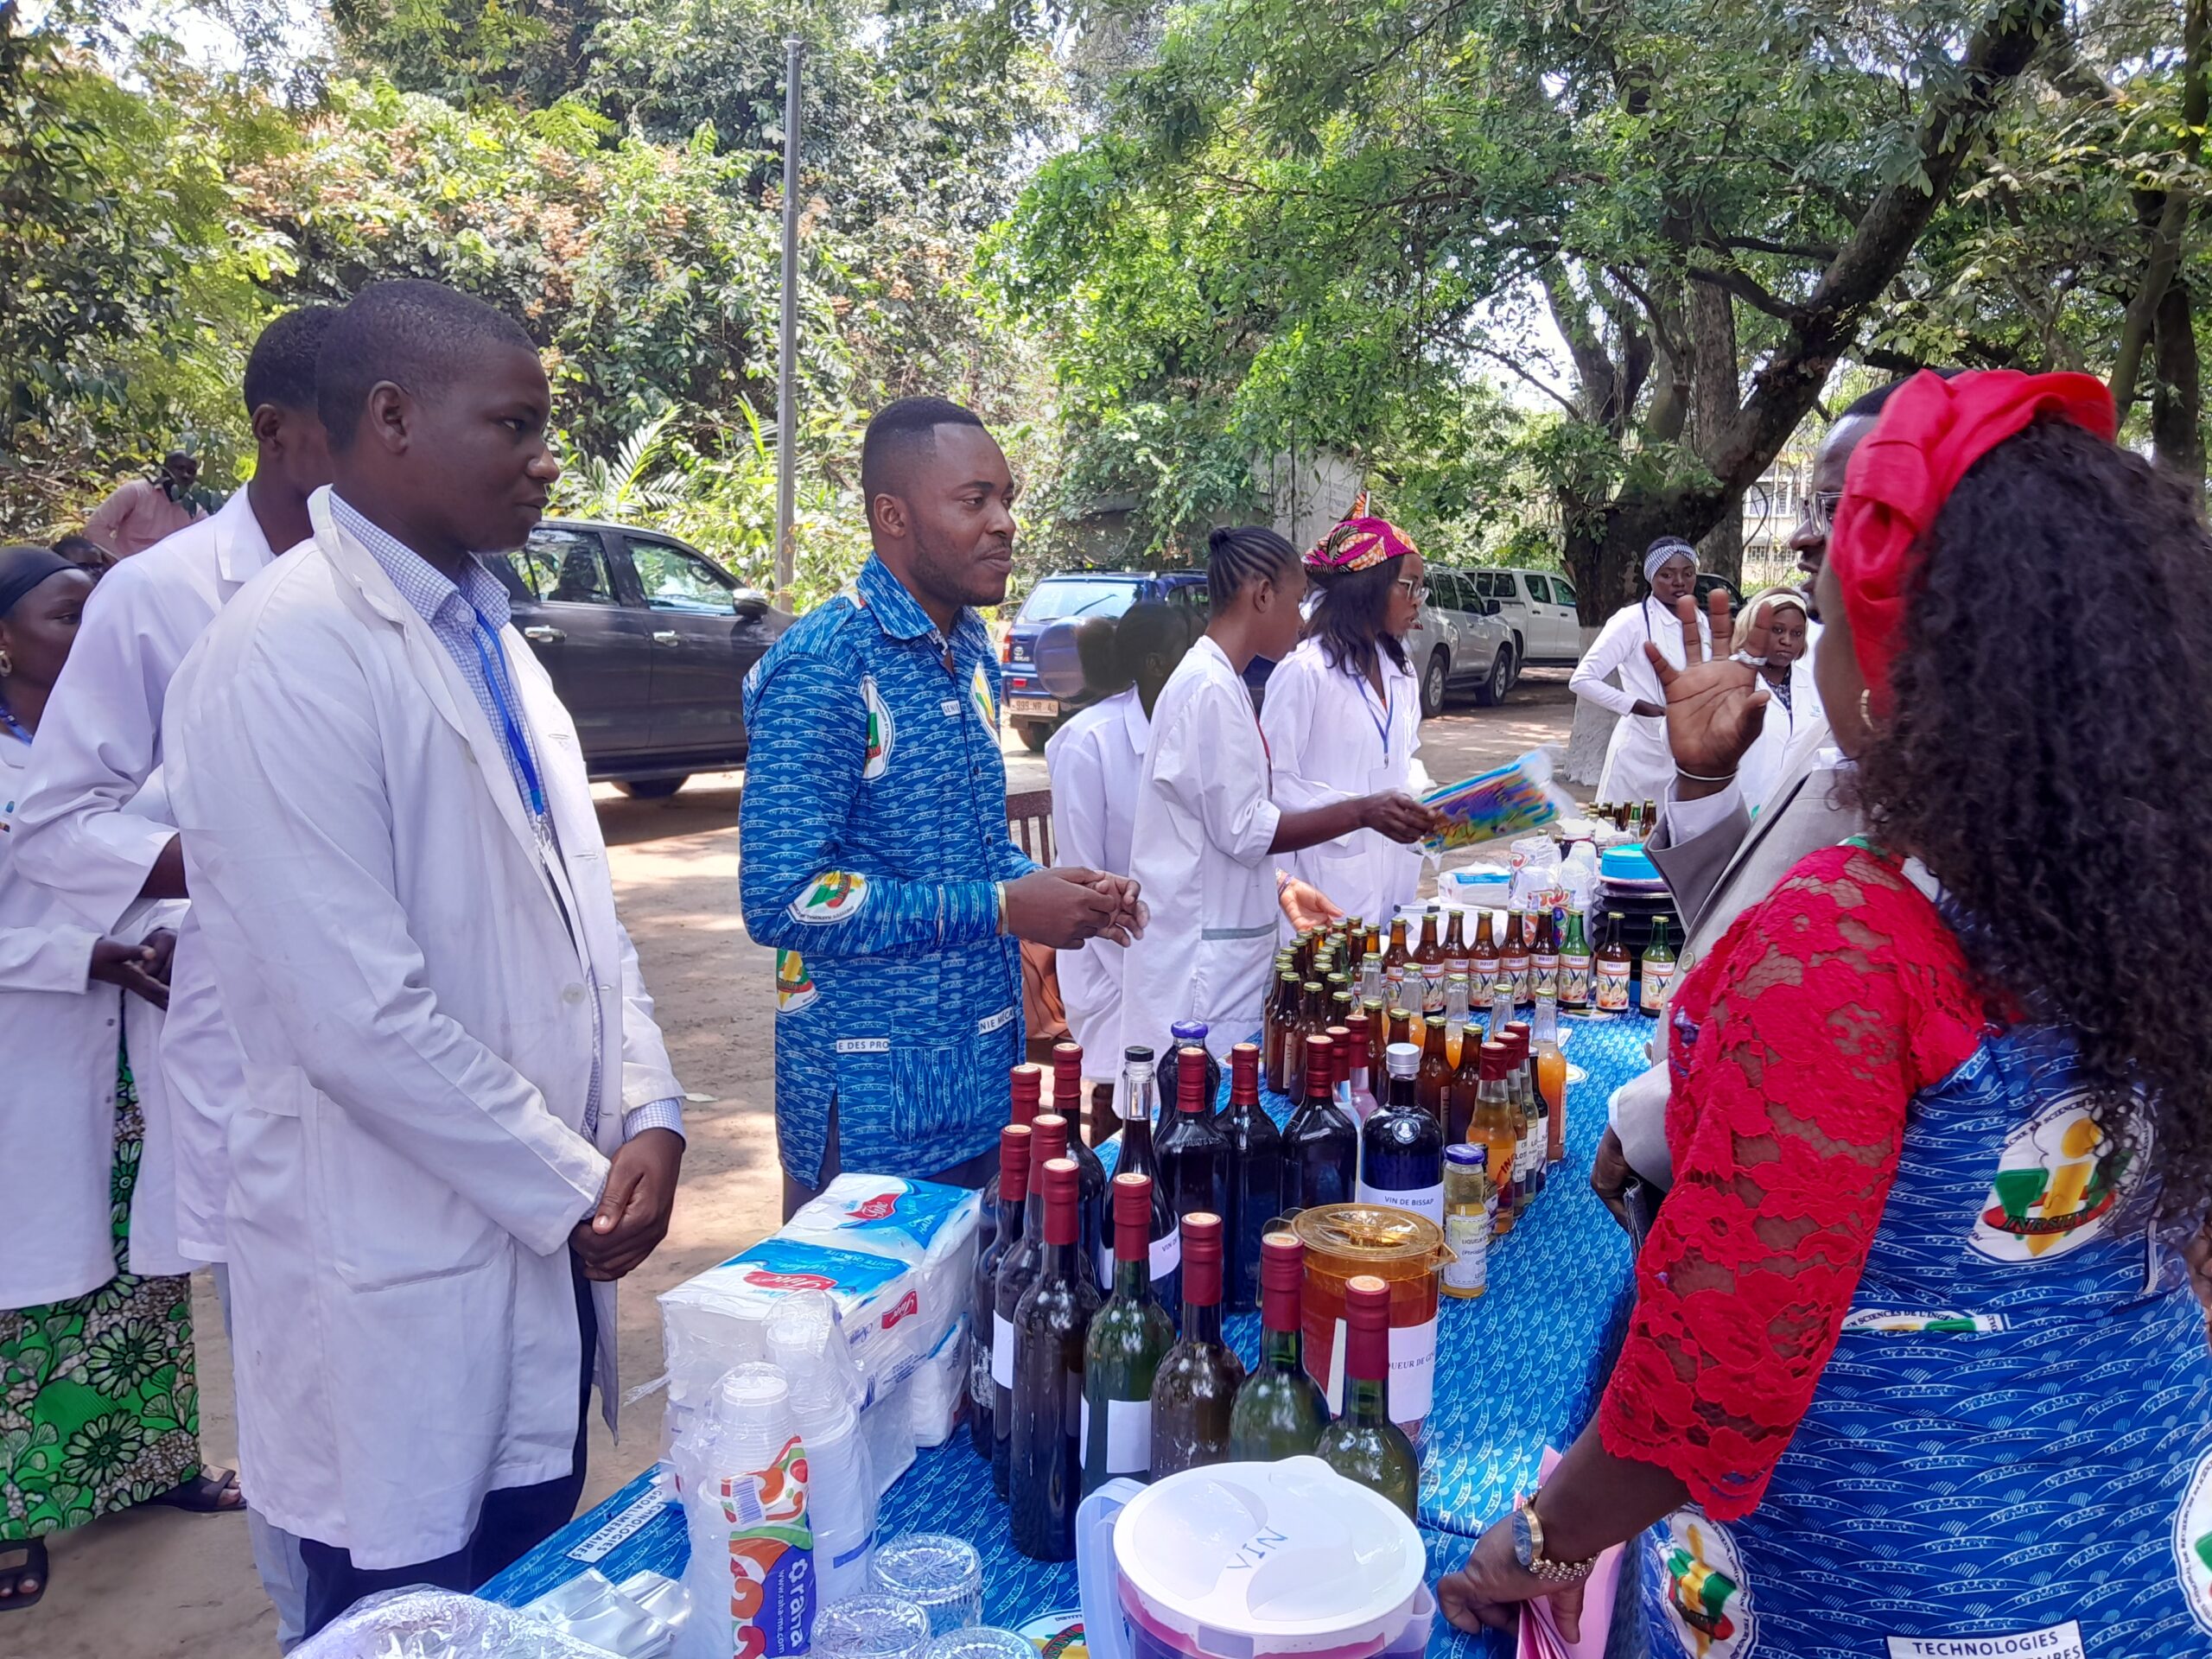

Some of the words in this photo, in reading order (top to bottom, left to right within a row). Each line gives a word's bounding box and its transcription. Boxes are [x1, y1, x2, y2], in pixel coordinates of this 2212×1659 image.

[848, 1041, 866, 1050] DES
[869, 1040, 889, 1050] PRO
[1384, 1196, 1398, 1205] VIN
[1400, 1198, 1409, 1206] DE
[1412, 1198, 1434, 1206] BISSAP
[1389, 1360, 1414, 1370] UEUR
[1416, 1357, 1426, 1367] DE
[1226, 1526, 1288, 1569] VIN
[1912, 1631, 2058, 1656] TECHNOLOGIES
